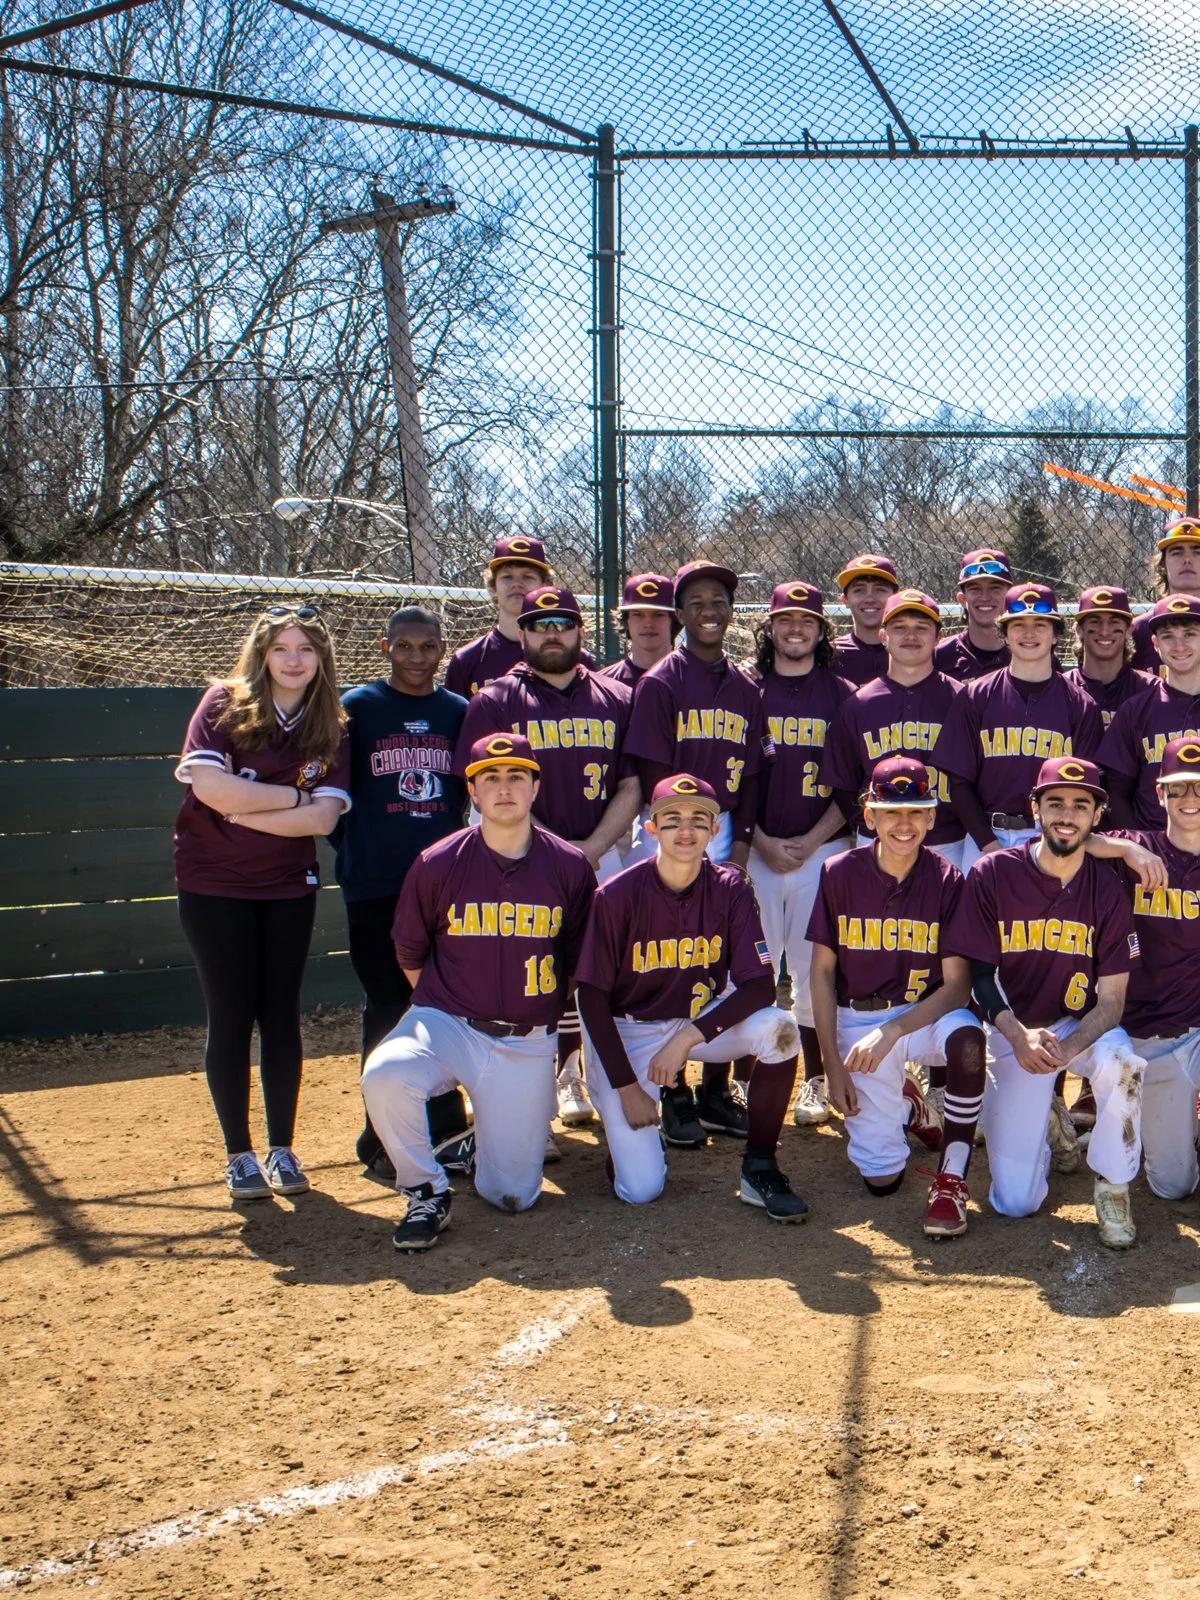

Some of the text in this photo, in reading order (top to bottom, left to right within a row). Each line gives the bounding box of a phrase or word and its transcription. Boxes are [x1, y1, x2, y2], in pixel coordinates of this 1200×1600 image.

[508, 539, 530, 552] C
[536, 593, 560, 608] C
[636, 582, 658, 597] C
[786, 586, 809, 600] C
[1091, 590, 1112, 604] C
[1167, 599, 1190, 612] C
[768, 716, 832, 747] NCER
[863, 720, 942, 760] LANCE
[980, 726, 1072, 758] LANCERS
[486, 738, 512, 755] C
[370, 748, 453, 776] CHAMPION
[1058, 763, 1085, 781] C
[672, 778, 698, 794] C
[448, 902, 562, 938] LANCERS
[838, 915, 940, 954] LANCERS
[998, 918, 1094, 958] LANCERS
[524, 954, 557, 996] 18
[904, 969, 930, 1002] 5
[690, 977, 716, 1019] 2
[1064, 972, 1089, 1011] 6
